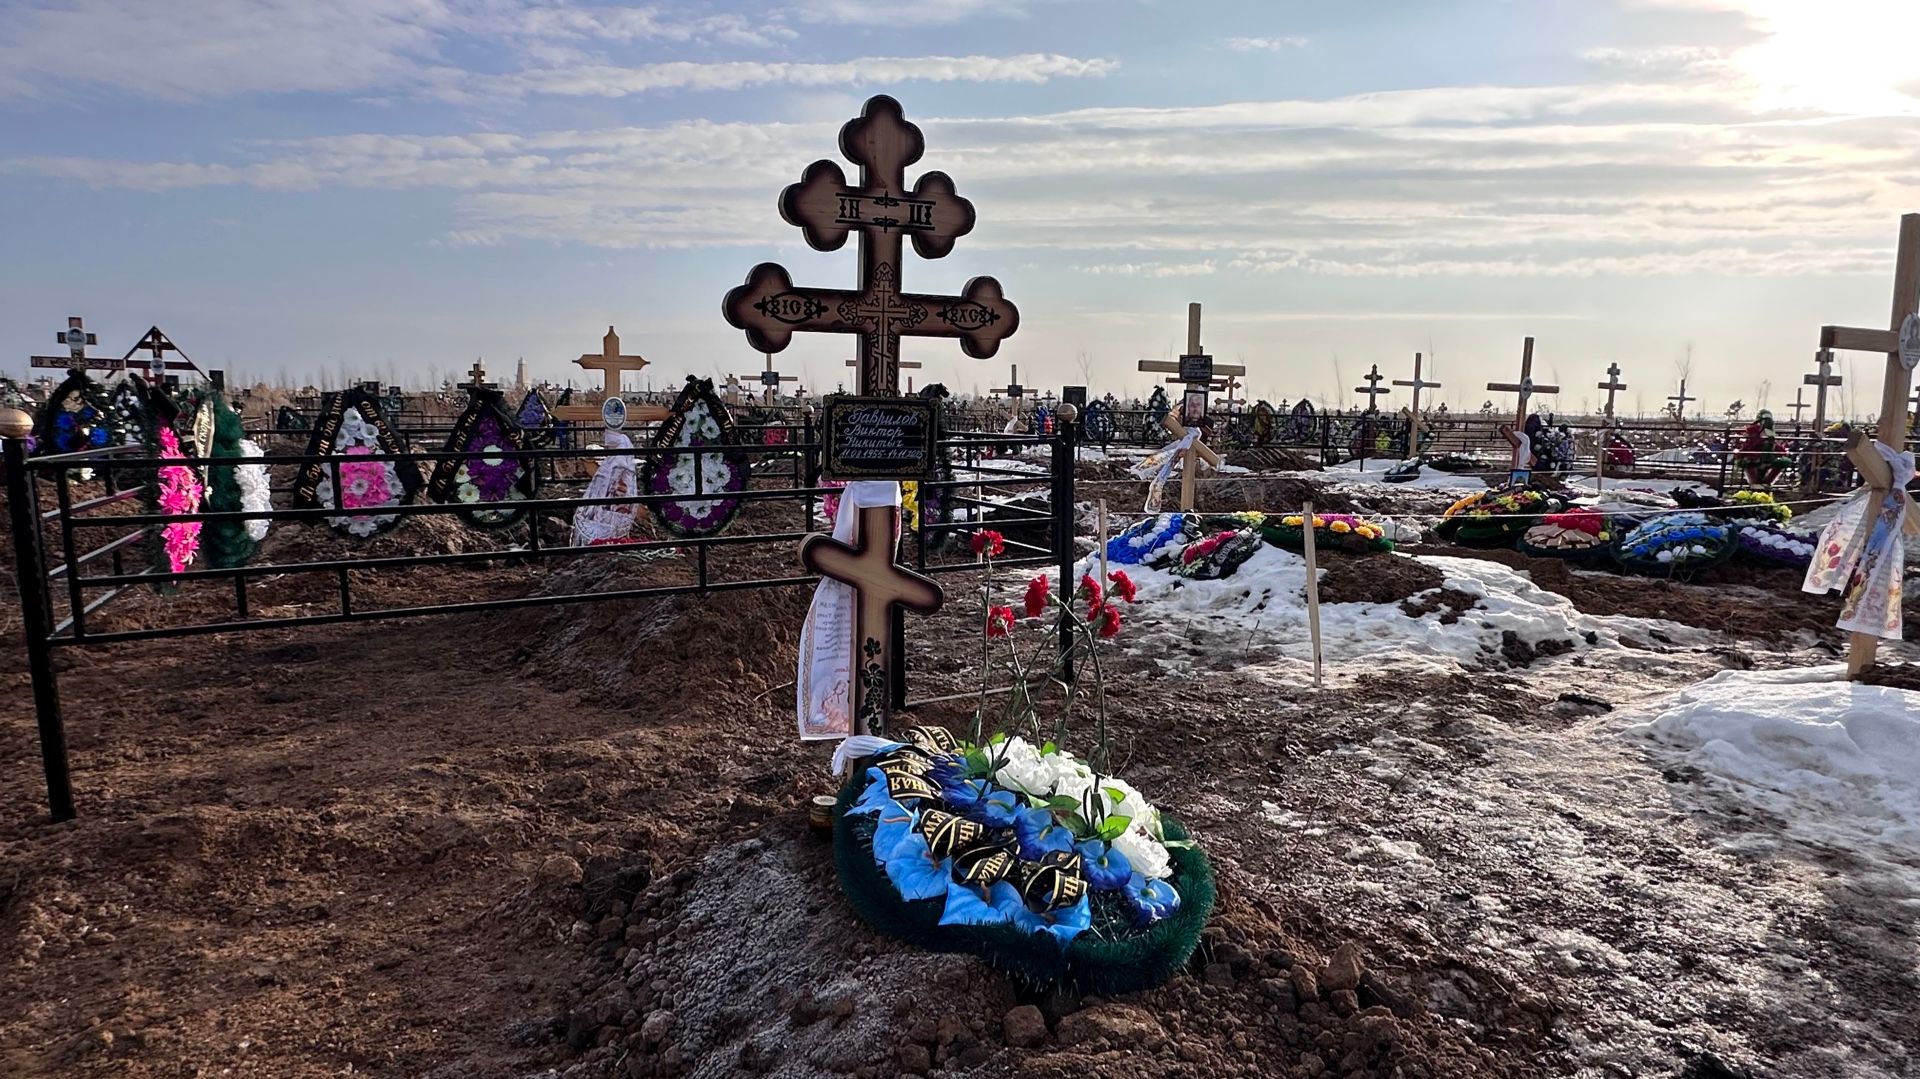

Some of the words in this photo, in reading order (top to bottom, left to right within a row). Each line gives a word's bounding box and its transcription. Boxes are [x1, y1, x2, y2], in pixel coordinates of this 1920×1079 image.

[360, 400, 377, 418] от
[848, 408, 919, 428] Гаврилов
[844, 424, 904, 440] Виктор
